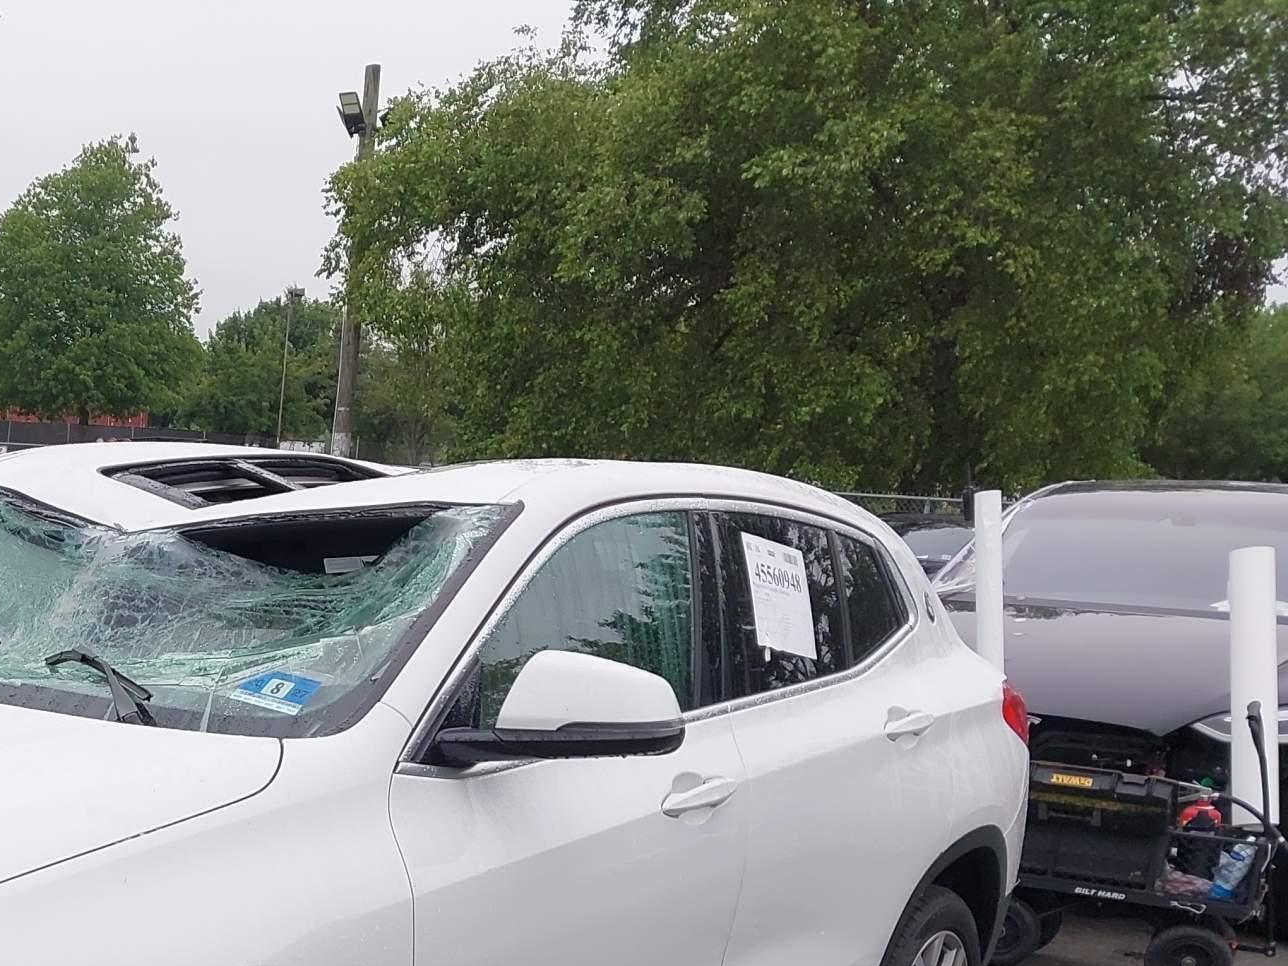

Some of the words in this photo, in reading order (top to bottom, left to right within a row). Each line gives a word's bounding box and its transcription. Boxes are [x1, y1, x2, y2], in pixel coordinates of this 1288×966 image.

[755, 561, 802, 593] 45560948
[270, 682, 285, 695] 8
[1097, 890, 1126, 900] HARD
